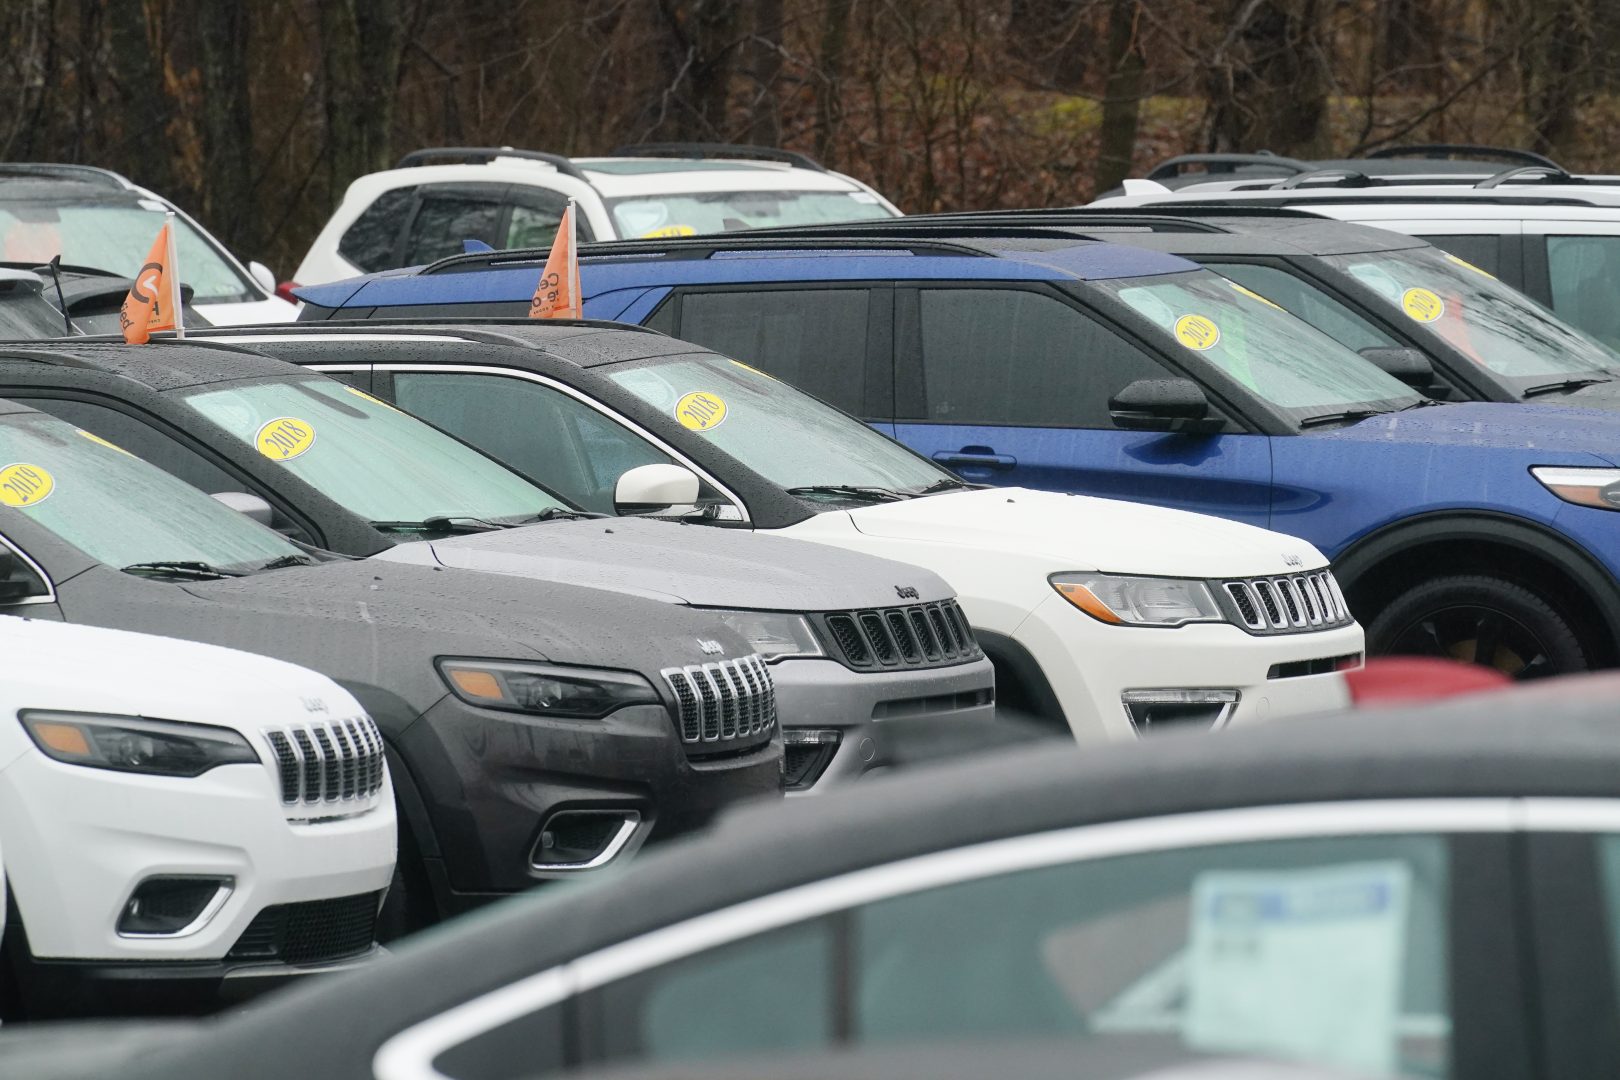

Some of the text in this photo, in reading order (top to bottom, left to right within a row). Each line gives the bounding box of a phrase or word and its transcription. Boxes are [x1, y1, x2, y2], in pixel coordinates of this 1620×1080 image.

[1182, 317, 1213, 347] 2020
[683, 395, 719, 427] 2018
[265, 421, 306, 457] 2018
[3, 466, 43, 502] 2019
[894, 585, 920, 600] Jeep
[696, 638, 725, 655] Jeep
